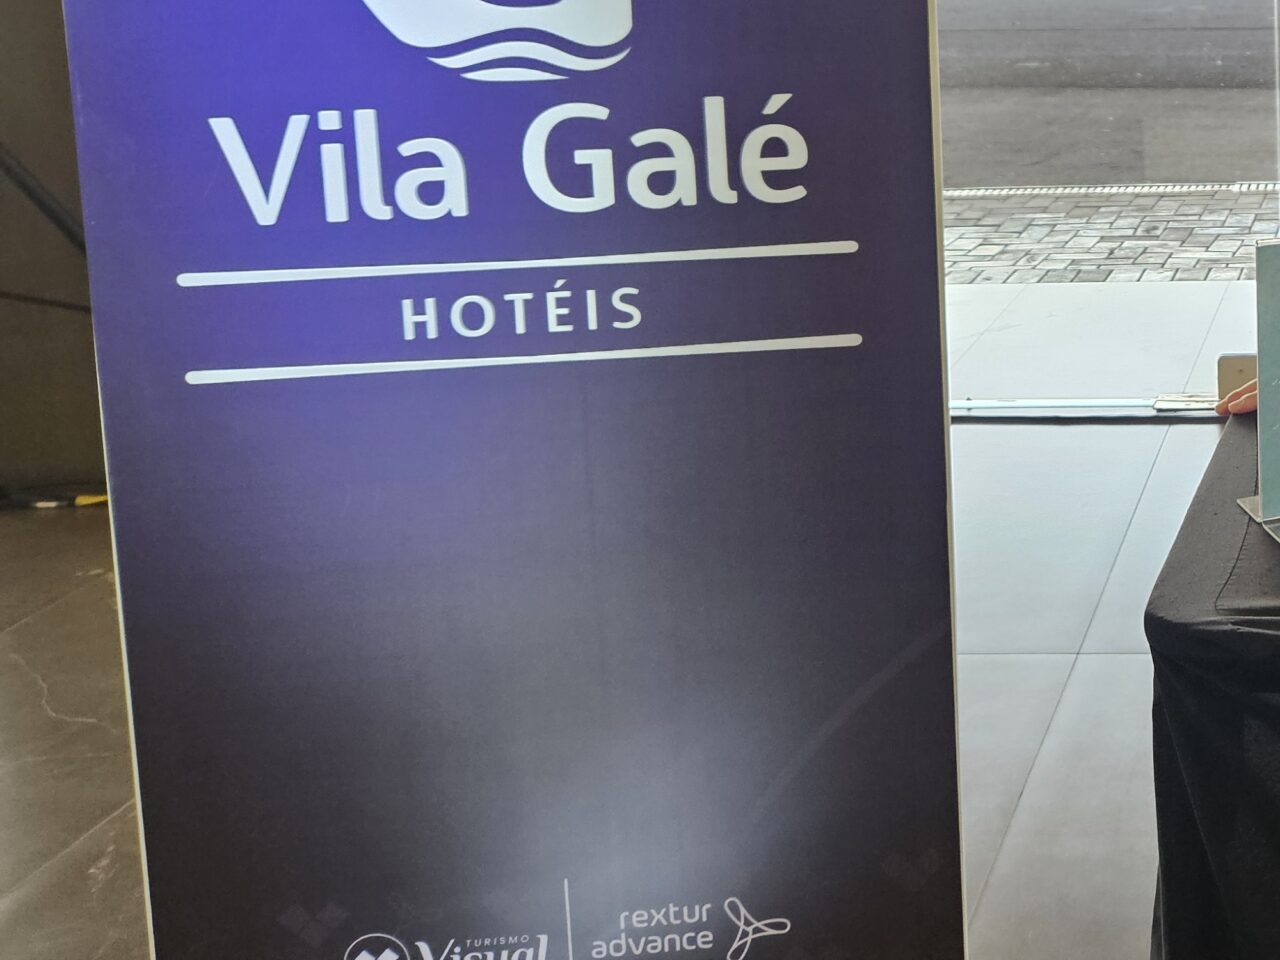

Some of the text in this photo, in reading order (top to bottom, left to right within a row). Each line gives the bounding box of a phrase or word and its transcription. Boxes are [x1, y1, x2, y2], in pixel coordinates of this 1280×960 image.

[208, 93, 810, 227] Vila Galé
[401, 279, 643, 341] HOTÉIS
[619, 902, 712, 930] rextur
[465, 934, 530, 948] TURISMO
[591, 929, 714, 959] advance
